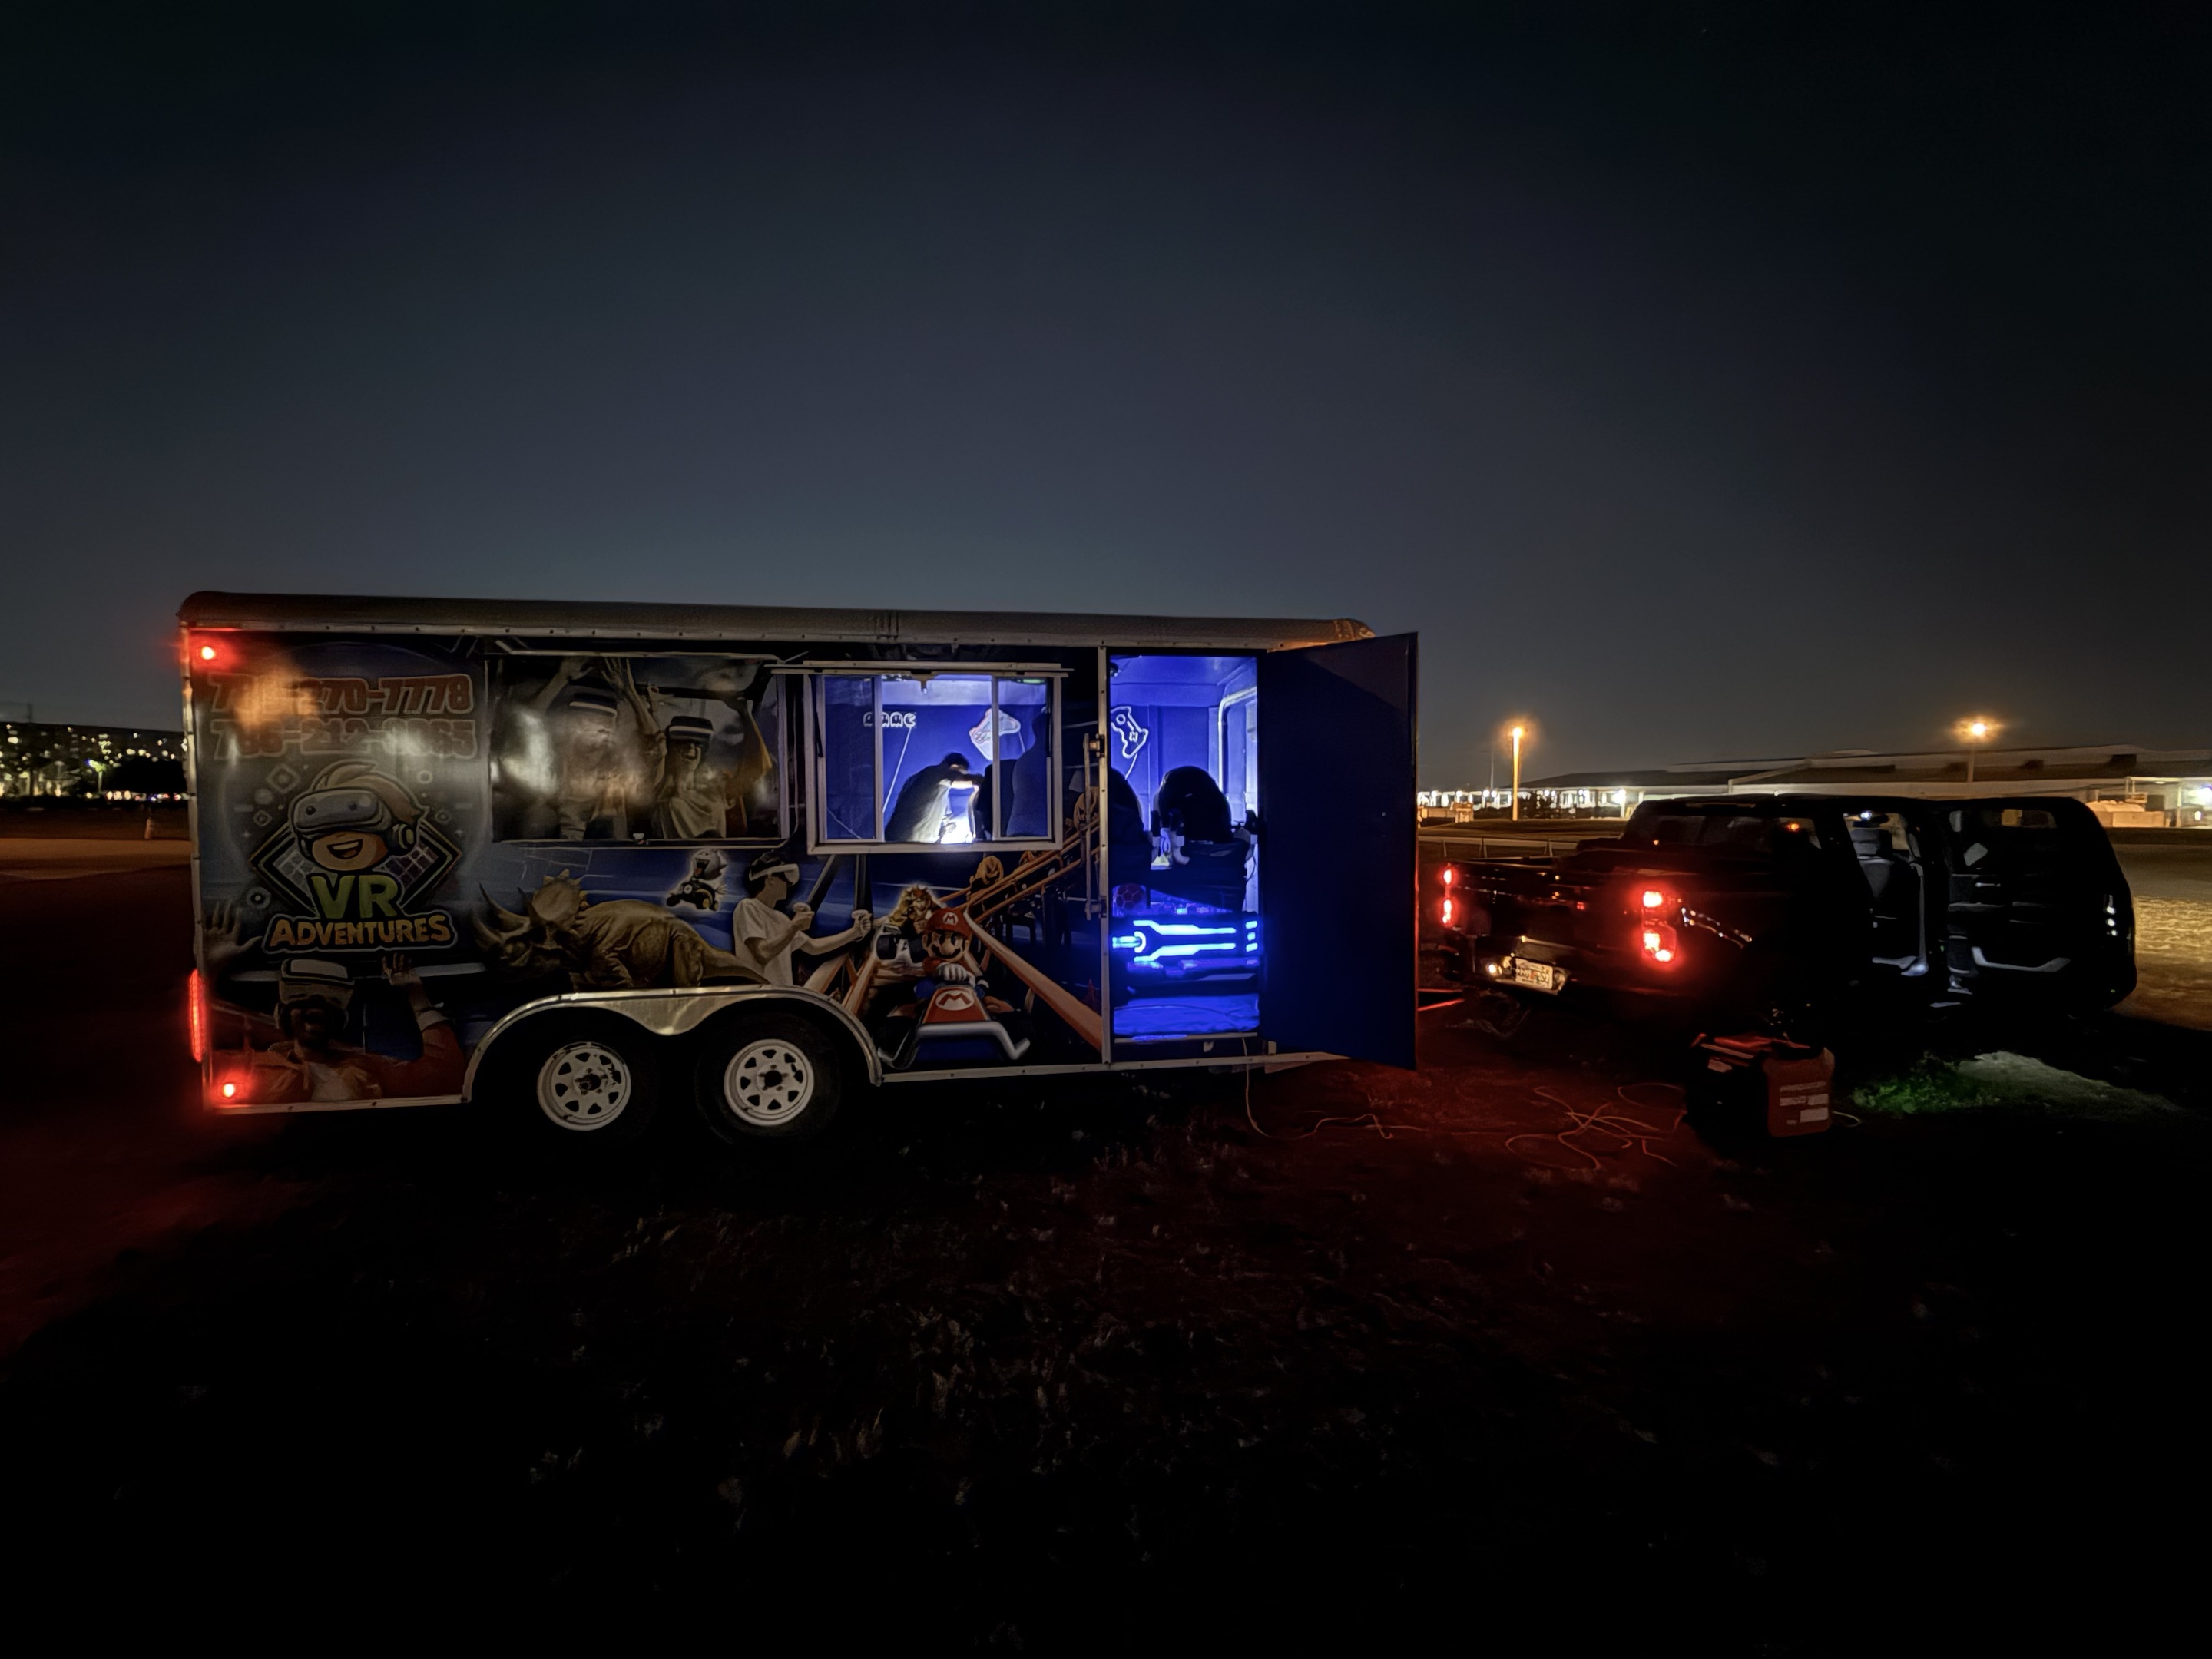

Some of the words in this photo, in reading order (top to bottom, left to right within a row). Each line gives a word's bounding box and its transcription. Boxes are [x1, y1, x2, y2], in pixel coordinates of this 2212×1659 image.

[208, 674, 473, 714] 7-70-7778
[210, 717, 477, 760] 76-212-65
[310, 874, 398, 919] VR
[269, 914, 452, 947] ADVENTURES
[944, 914, 956, 926] M
[939, 993, 972, 1005] M
